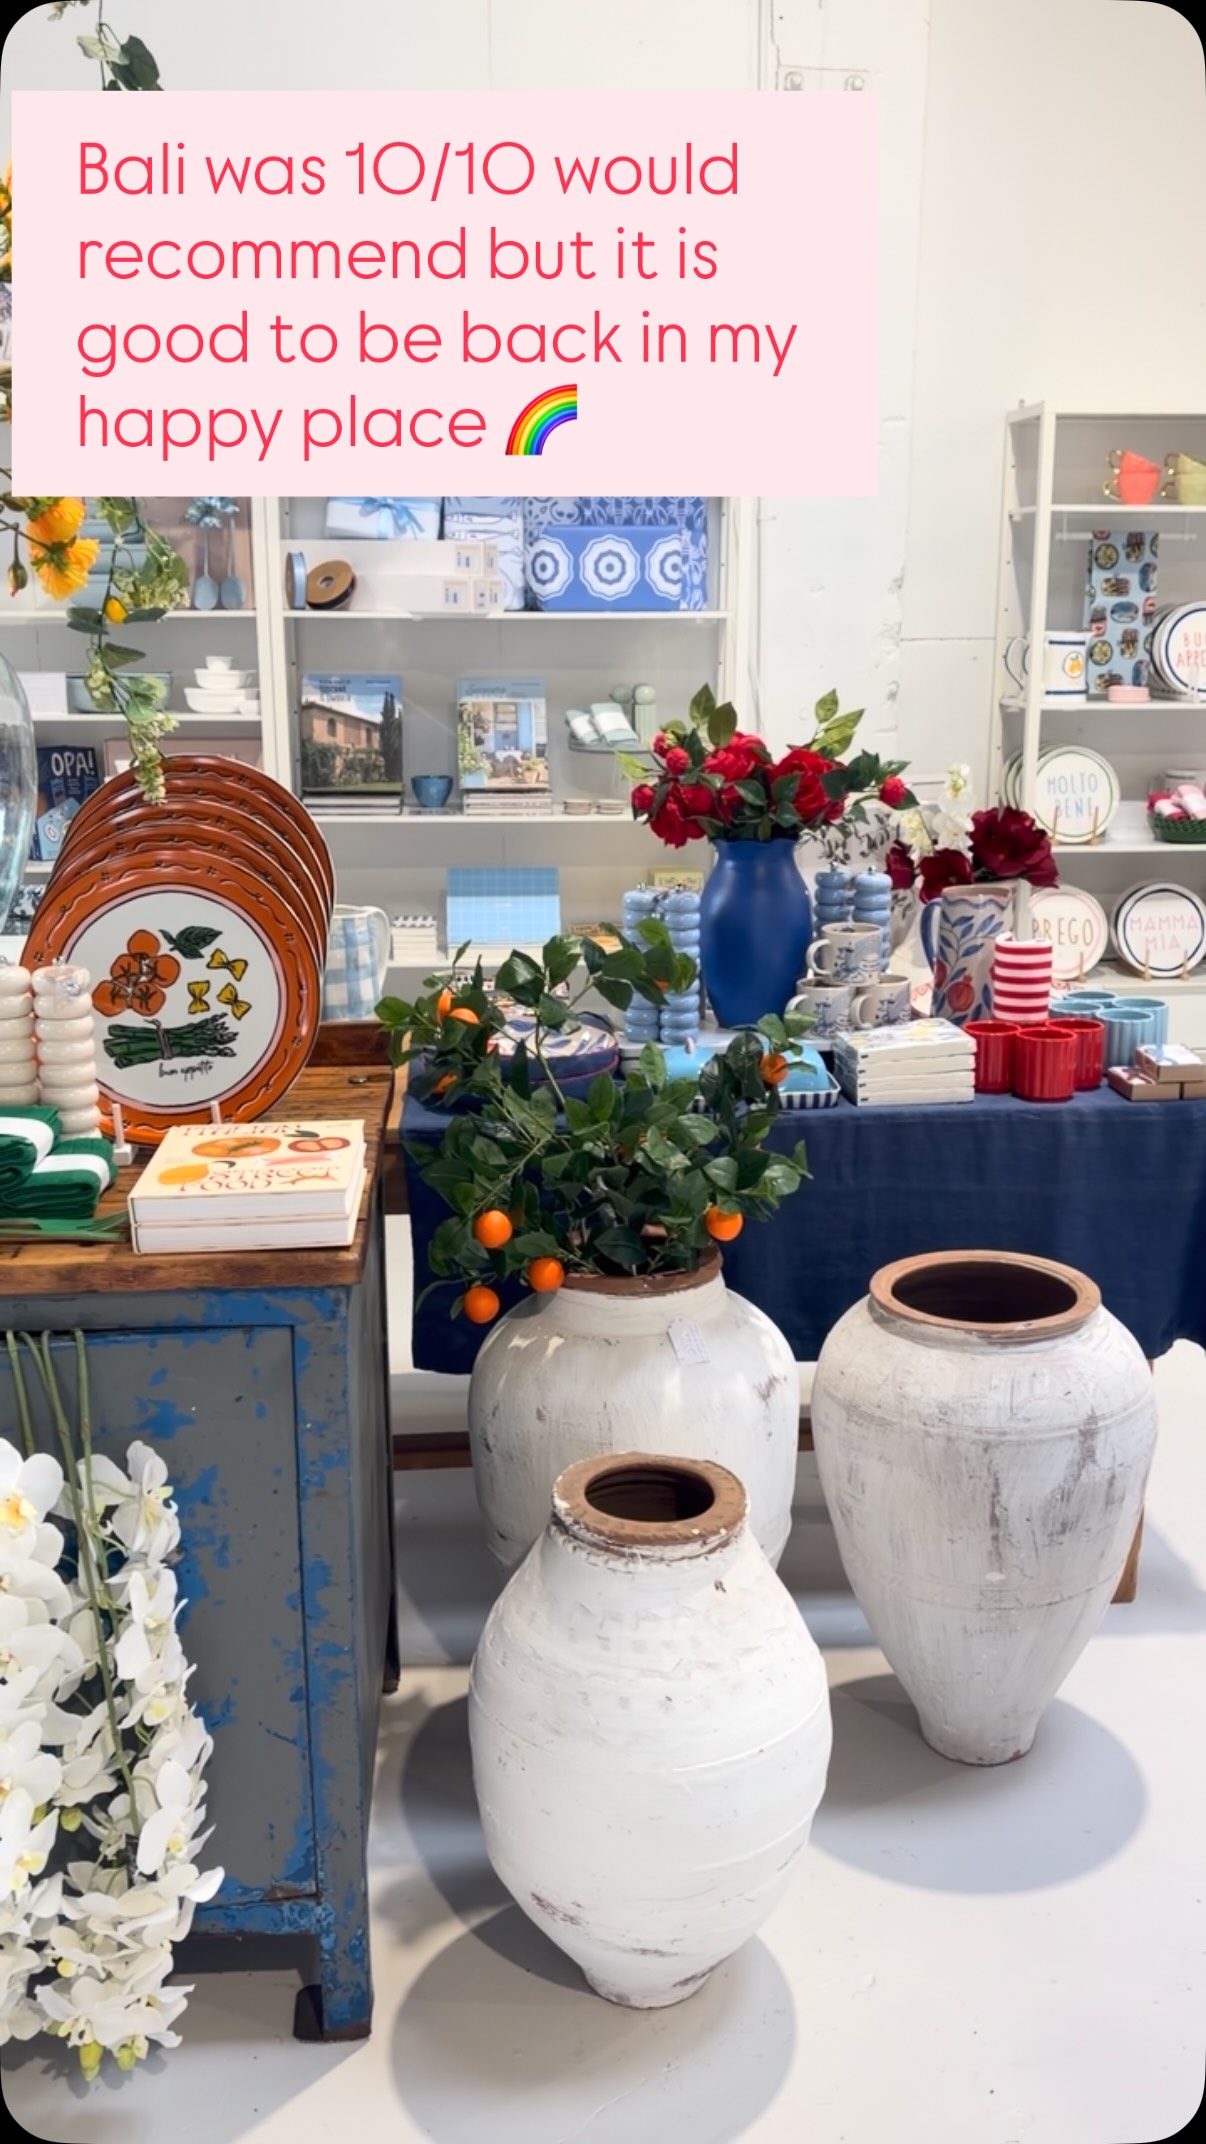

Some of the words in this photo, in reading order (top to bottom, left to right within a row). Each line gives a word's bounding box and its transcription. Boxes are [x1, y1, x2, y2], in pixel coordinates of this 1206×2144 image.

[1183, 632, 1206, 647] BU
[51, 750, 95, 776] OPA!
[1046, 772, 1098, 795] MOLTO
[1031, 916, 1094, 946] PREGO
[1129, 914, 1198, 932] MAMMA
[1144, 933, 1181, 951] MIA
[208, 1166, 340, 1180] STREET
